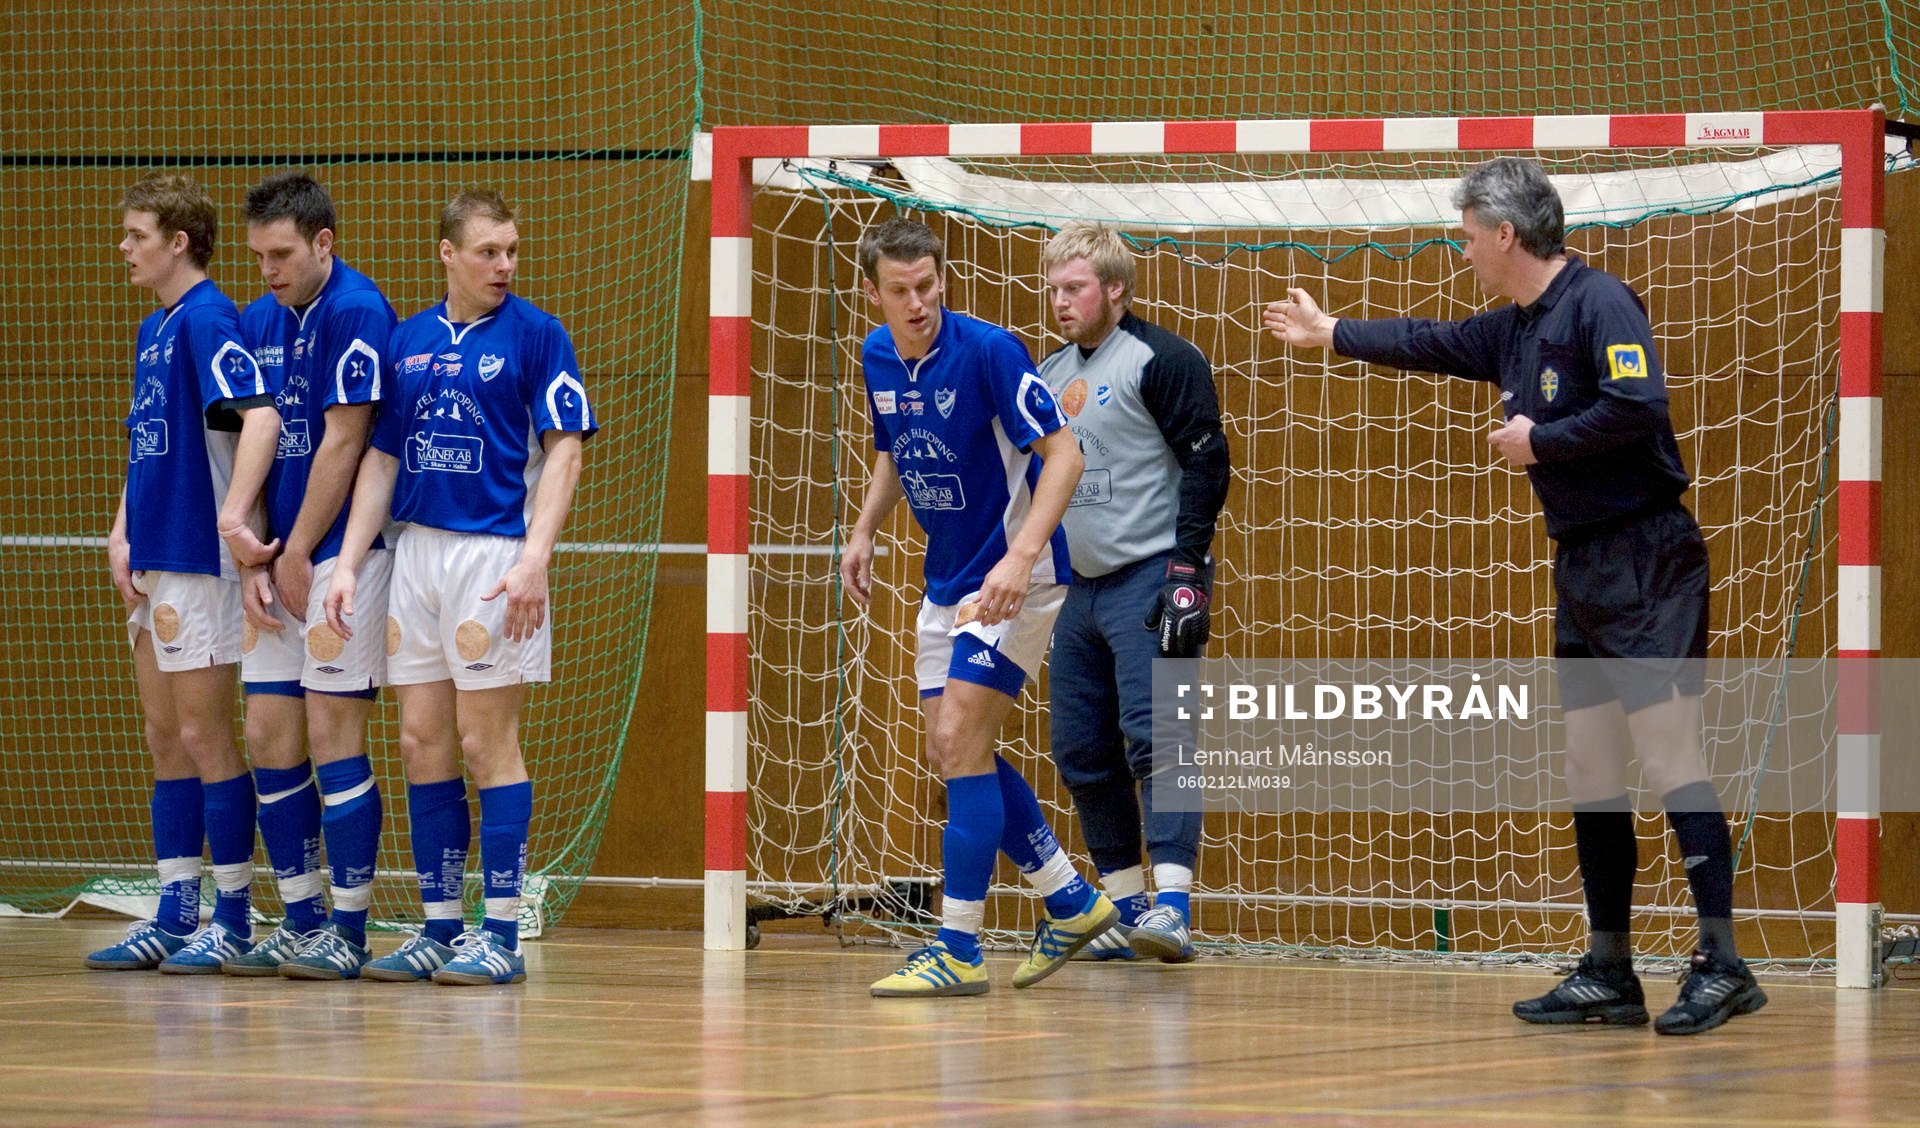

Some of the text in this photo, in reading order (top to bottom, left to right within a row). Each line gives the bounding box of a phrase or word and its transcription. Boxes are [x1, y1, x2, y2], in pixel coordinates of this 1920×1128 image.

[456, 450, 472, 463] AB
[905, 470, 929, 490] SA
[967, 657, 995, 669] adidas
[345, 864, 371, 886] IFK
[490, 869, 514, 888] IFK
